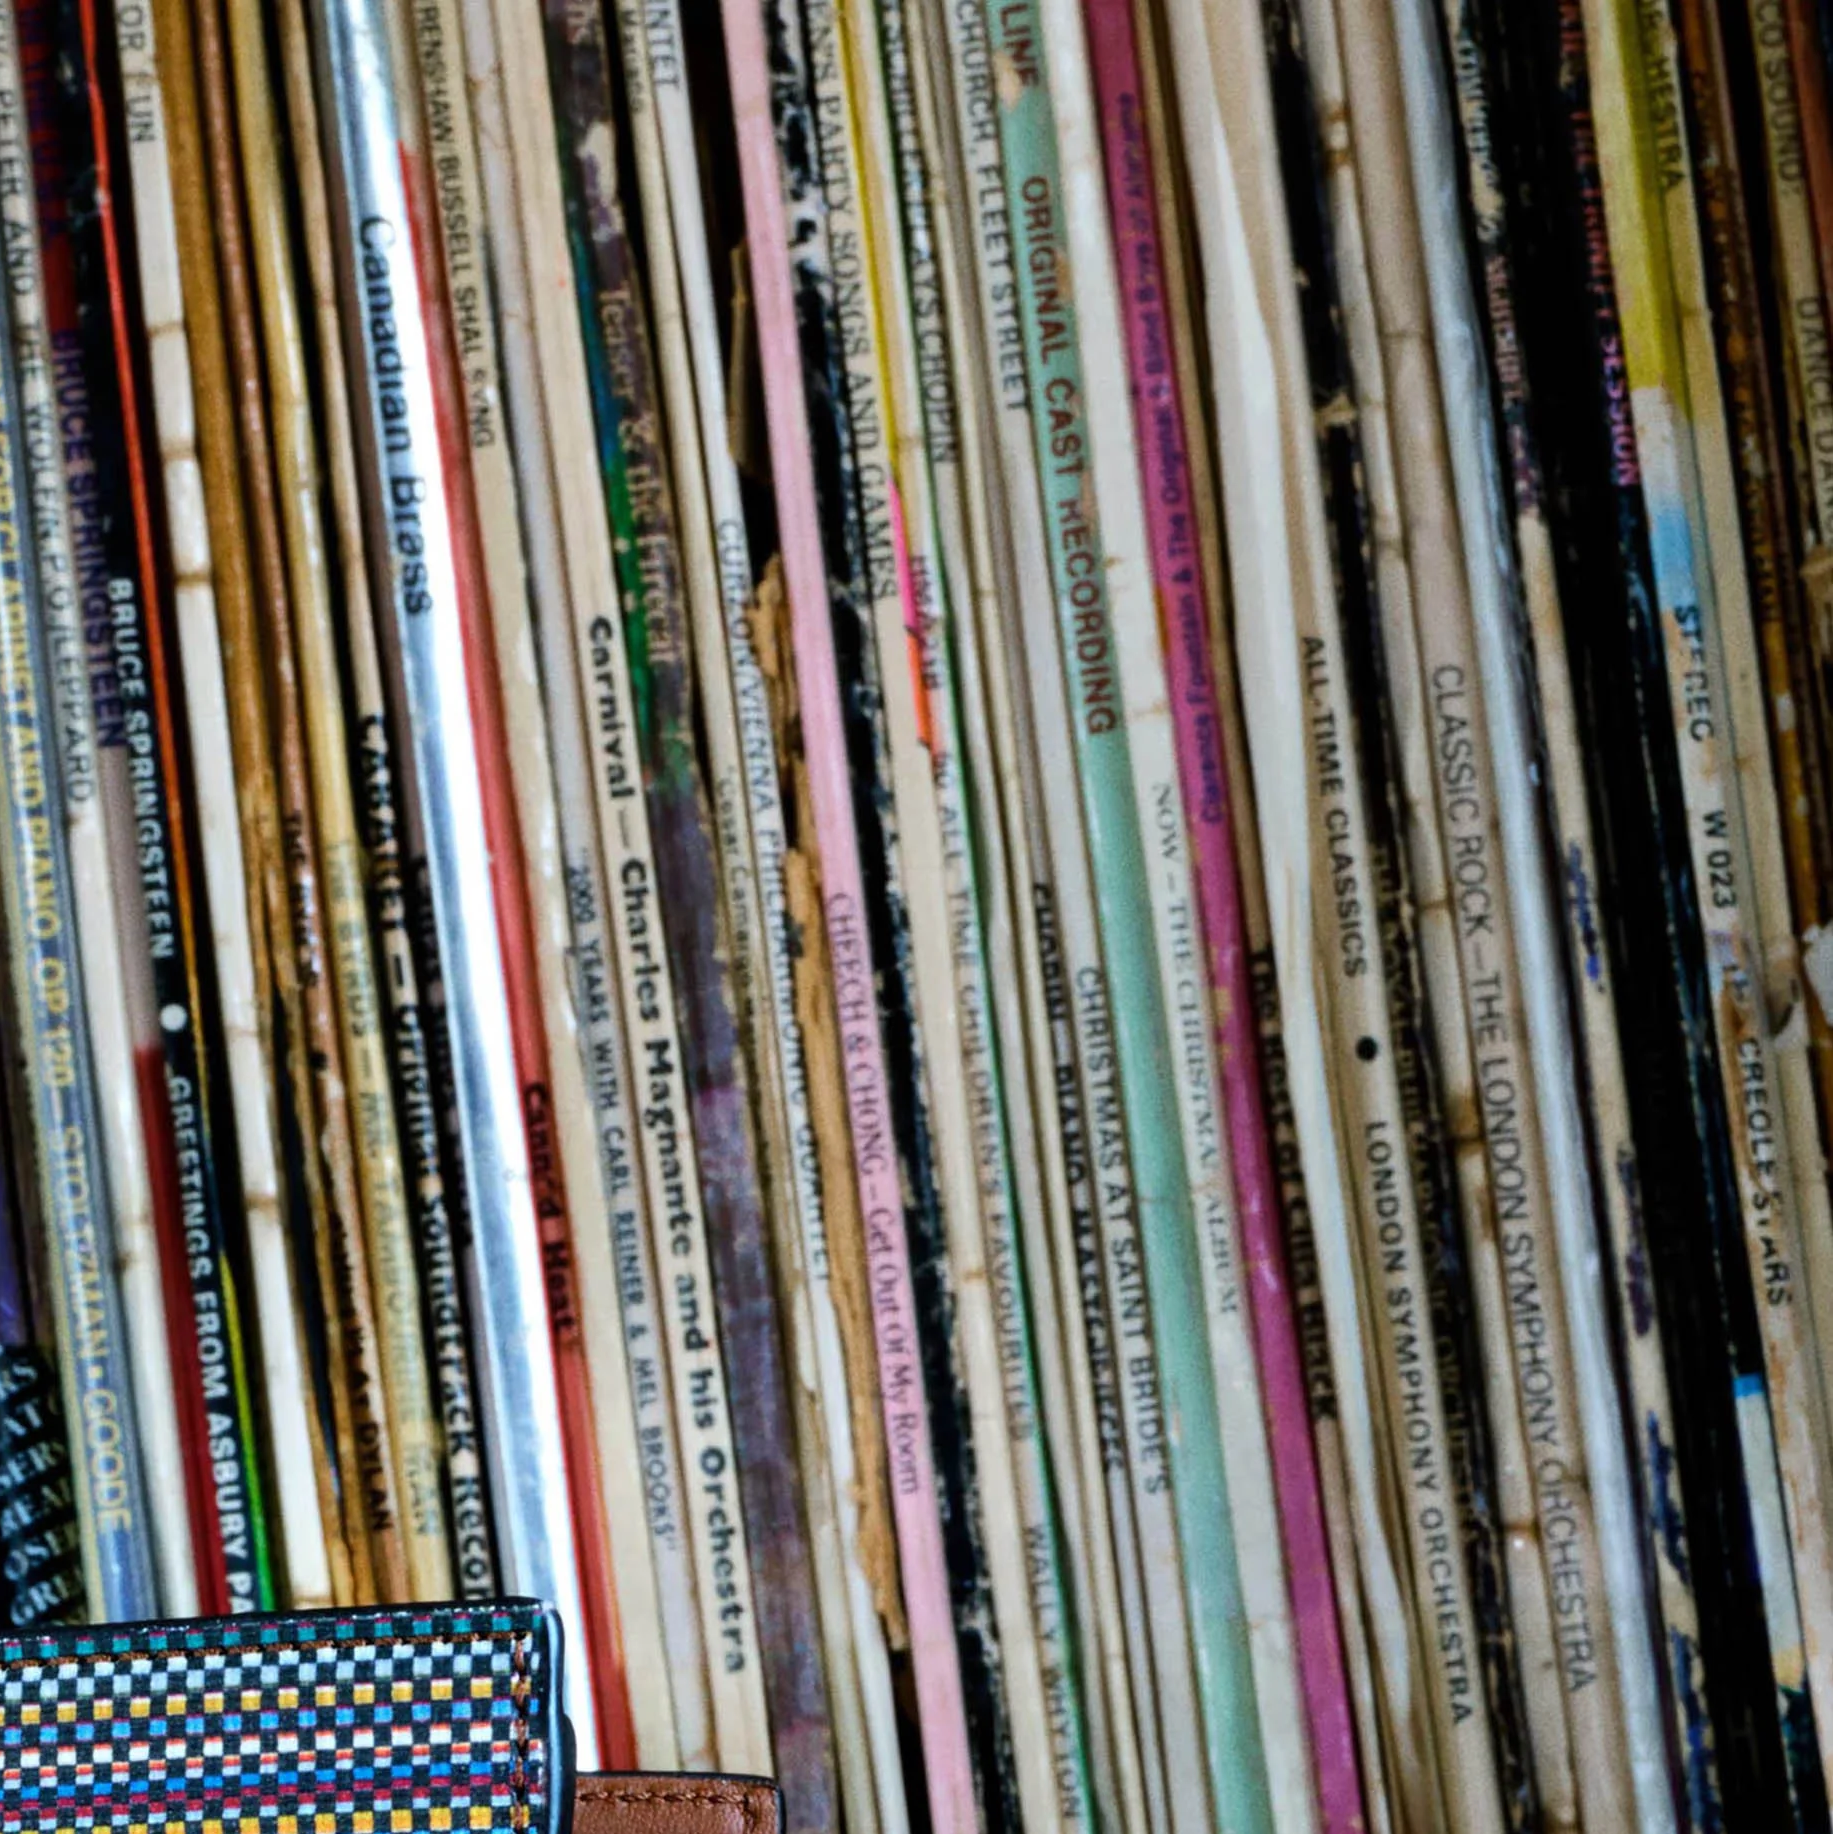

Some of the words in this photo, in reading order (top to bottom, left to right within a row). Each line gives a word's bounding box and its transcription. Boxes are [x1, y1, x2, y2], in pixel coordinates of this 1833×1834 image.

[813, 94, 853, 216] PARTY
[2, 218, 37, 297] AND
[974, 163, 1011, 271] FLEET
[1019, 174, 1072, 364] ORIGINAL
[13, 317, 47, 385] THE
[829, 229, 870, 359] SONGS
[990, 283, 1030, 417] STREET
[354, 211, 420, 455] Canadian
[387, 470, 440, 618] Brass
[595, 285, 642, 399] Teaser
[620, 464, 659, 521] the
[845, 368, 881, 453] AND
[1044, 376, 1086, 477] CAST
[856, 461, 899, 601] GAMES
[65, 472, 126, 750] SPRINGSTEEN
[104, 576, 145, 700] BRUCE
[1059, 496, 1117, 736] RECORDING
[584, 614, 637, 802] Carnival
[1431, 663, 1482, 823] CLASSIC
[120, 709, 176, 961] SPRINGSTEEN
[1151, 782, 1183, 866] NOW
[1705, 848, 1737, 910] 023
[576, 939, 610, 1025] YEARS
[616, 857, 666, 1023] Charles
[824, 890, 868, 1027] CHEECH
[1165, 896, 1196, 974] THE
[589, 1038, 622, 1112] WITH
[842, 1031, 872, 1058] &
[1073, 966, 1126, 1169] CHRISTMAS
[7, 721, 50, 810] AND
[82, 1386, 131, 1537] GOODE
[164, 1074, 214, 1280] GREETINGS
[600, 1125, 632, 1197] CARL
[640, 1038, 697, 1259] Magnante
[846, 1066, 886, 1179] CHONG
[1300, 634, 1345, 798] ALL-TIME
[1324, 808, 1371, 978] CLASSICS
[1367, 1121, 1412, 1273] LONDON
[1390, 1284, 1442, 1491] SYMPHONY
[1420, 1506, 1475, 1727] ORCHESTRA
[1483, 1057, 1535, 1221] LONDON
[610, 1209, 646, 1308] REINER
[863, 1207, 896, 1258] Get
[1103, 1178, 1134, 1225] AT
[1203, 1193, 1238, 1316] ALBUM
[189, 1290, 228, 1400] FROM
[671, 1271, 710, 1352] and
[870, 1263, 903, 1313] Out
[877, 1319, 908, 1356] Of
[1111, 1235, 1150, 1341] SAINT
[1506, 1231, 1566, 1447] SYMPHONY
[629, 1355, 659, 1411] MEL
[684, 1367, 720, 1430] his
[882, 1361, 914, 1406] My
[1127, 1354, 1172, 1496] BRIDE'S
[204, 1410, 248, 1563] ASBURY
[888, 1411, 926, 1496] Room
[694, 1444, 752, 1674] Orchestra
[1536, 1458, 1599, 1692] ORCHESTRA
